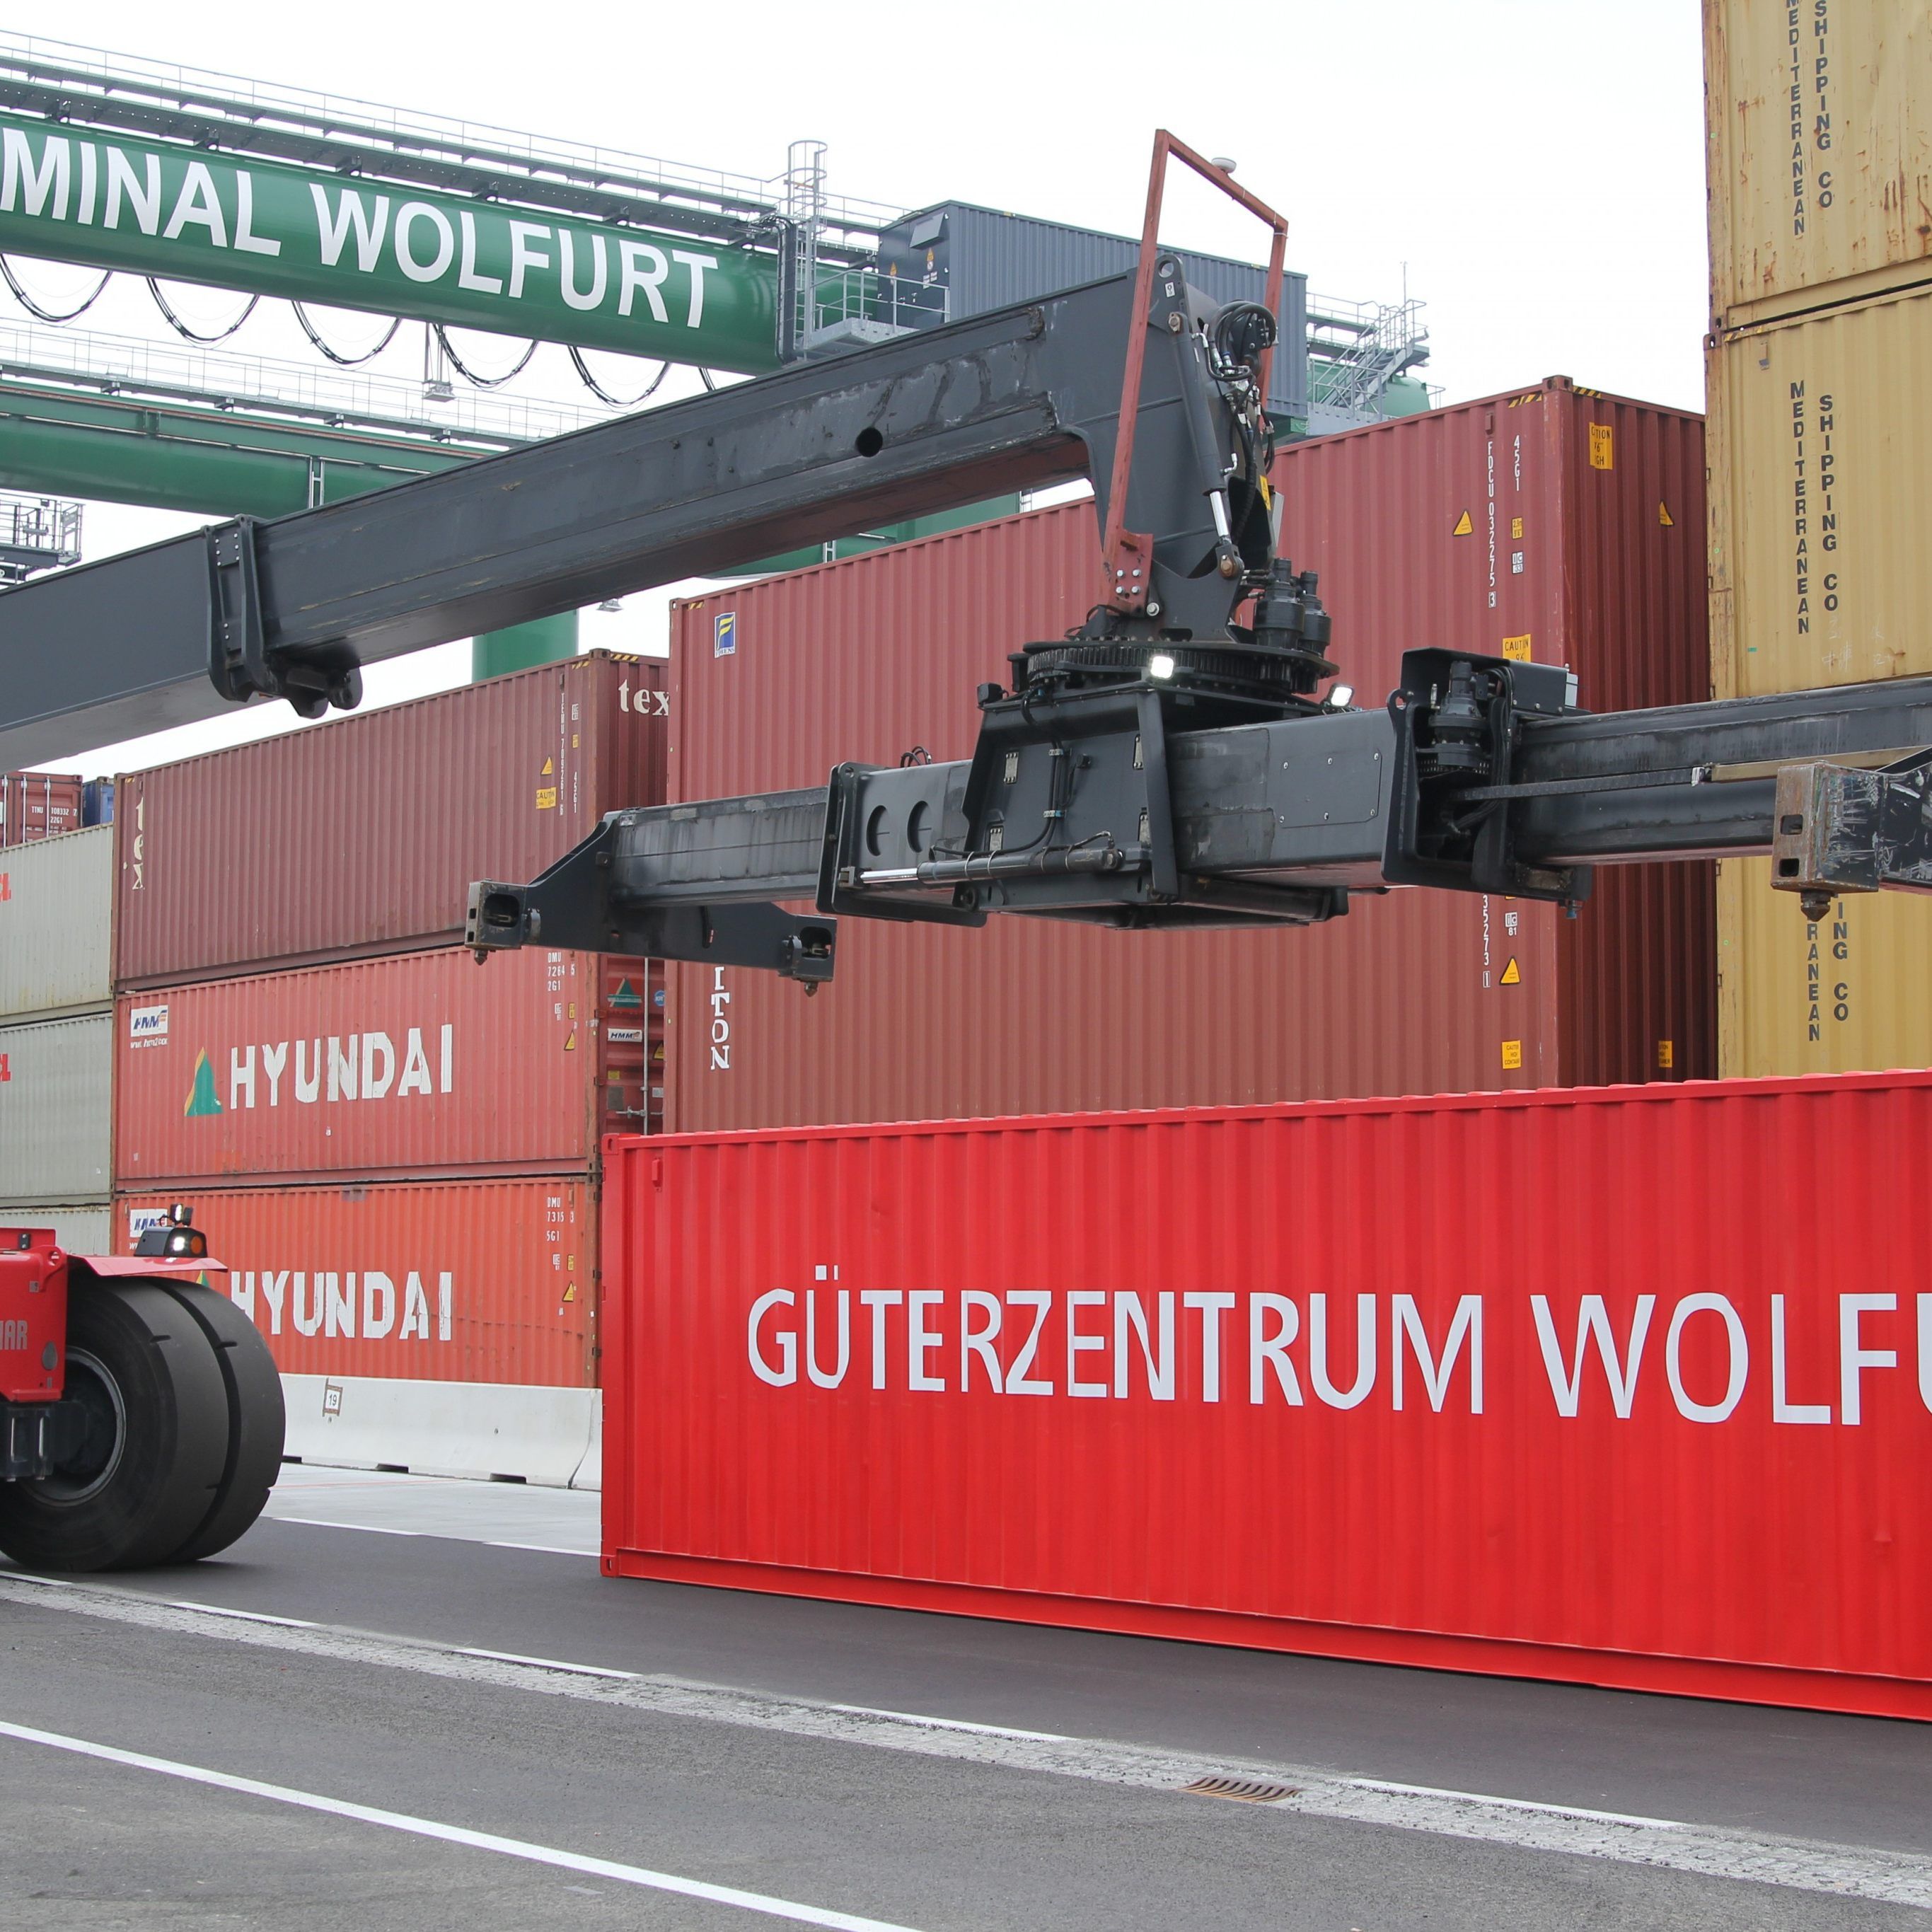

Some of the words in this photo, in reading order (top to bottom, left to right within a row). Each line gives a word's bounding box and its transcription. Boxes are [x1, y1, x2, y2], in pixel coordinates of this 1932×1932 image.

[1815, 0, 1832, 151] SHIPPING
[1818, 171, 1833, 208] CO
[0, 127, 282, 256] MINAL
[309, 183, 720, 328] WOLFURT
[1791, 380, 1809, 635] MEDITERRANEAN
[1819, 394, 1837, 552] SHIPPING
[1488, 591, 1496, 608] 3
[1823, 573, 1839, 612] CO
[618, 679, 669, 716] tex
[1834, 982, 1849, 1022] CO
[230, 1023, 453, 1109] HYUNDAI
[231, 1271, 452, 1341] HYUNDAI
[747, 1265, 1483, 1415] GÜTERZENTRUM
[1529, 1292, 1932, 1425] WOLF
[329, 1394, 337, 1406] 19
